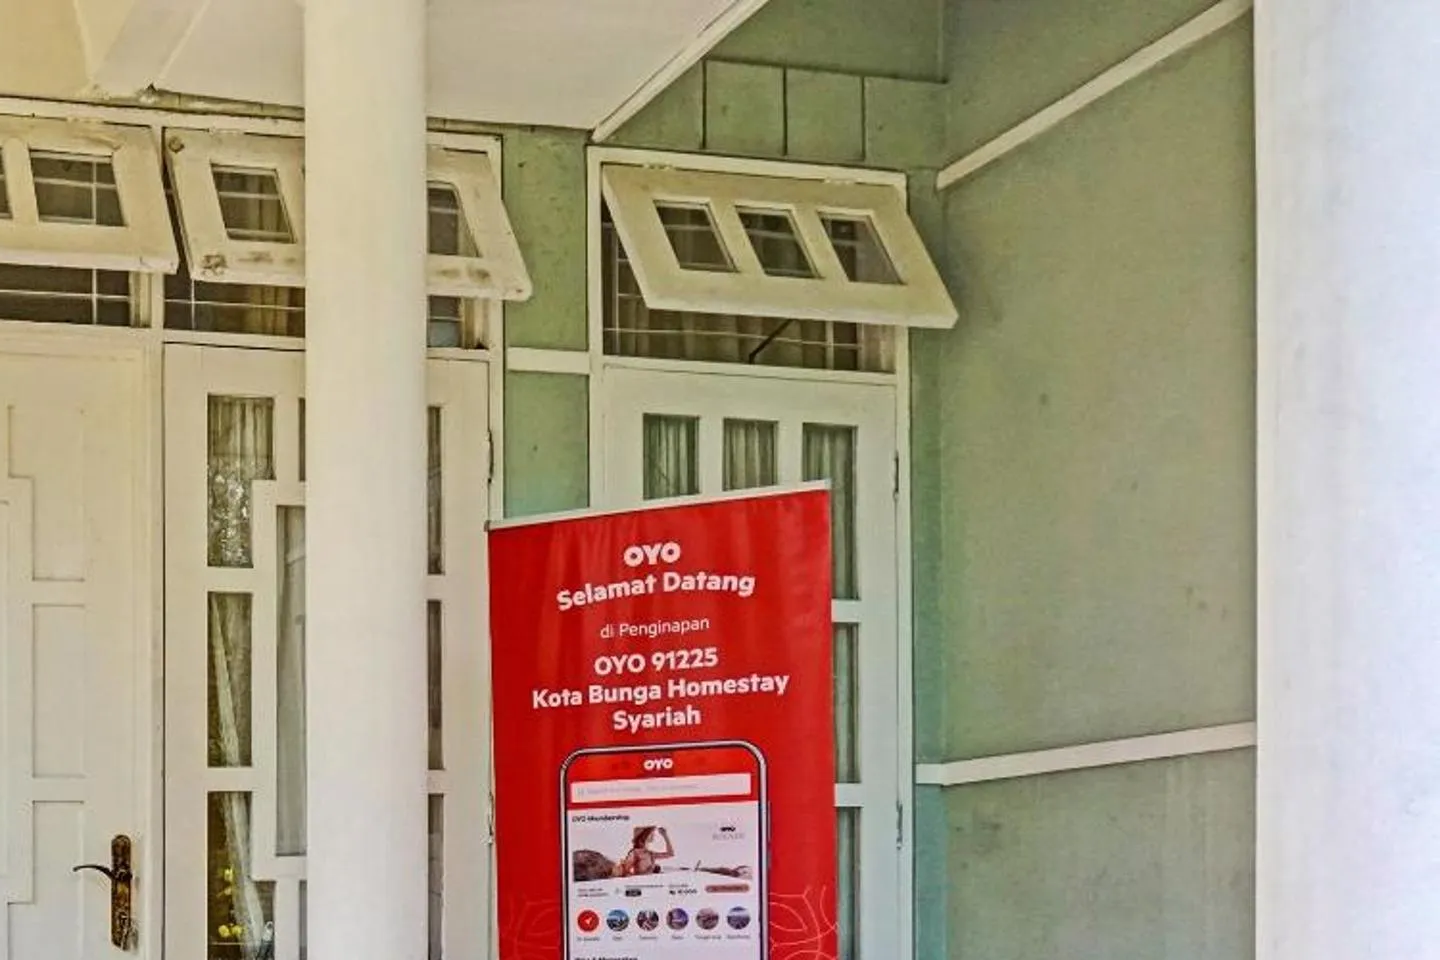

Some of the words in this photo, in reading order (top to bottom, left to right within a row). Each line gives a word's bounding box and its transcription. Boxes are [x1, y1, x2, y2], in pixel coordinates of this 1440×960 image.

[623, 541, 681, 567] OYO
[556, 577, 657, 611] Selamat
[663, 571, 755, 597] Datang
[600, 623, 615, 639] di
[619, 617, 710, 638] Penginapan
[594, 653, 646, 676] OYO
[651, 647, 719, 672] 91225
[532, 687, 583, 709] Kota
[588, 681, 662, 705] Bunga
[667, 674, 790, 699] Homestay
[613, 704, 702, 734] Syariah
[644, 758, 673, 770] OYO
